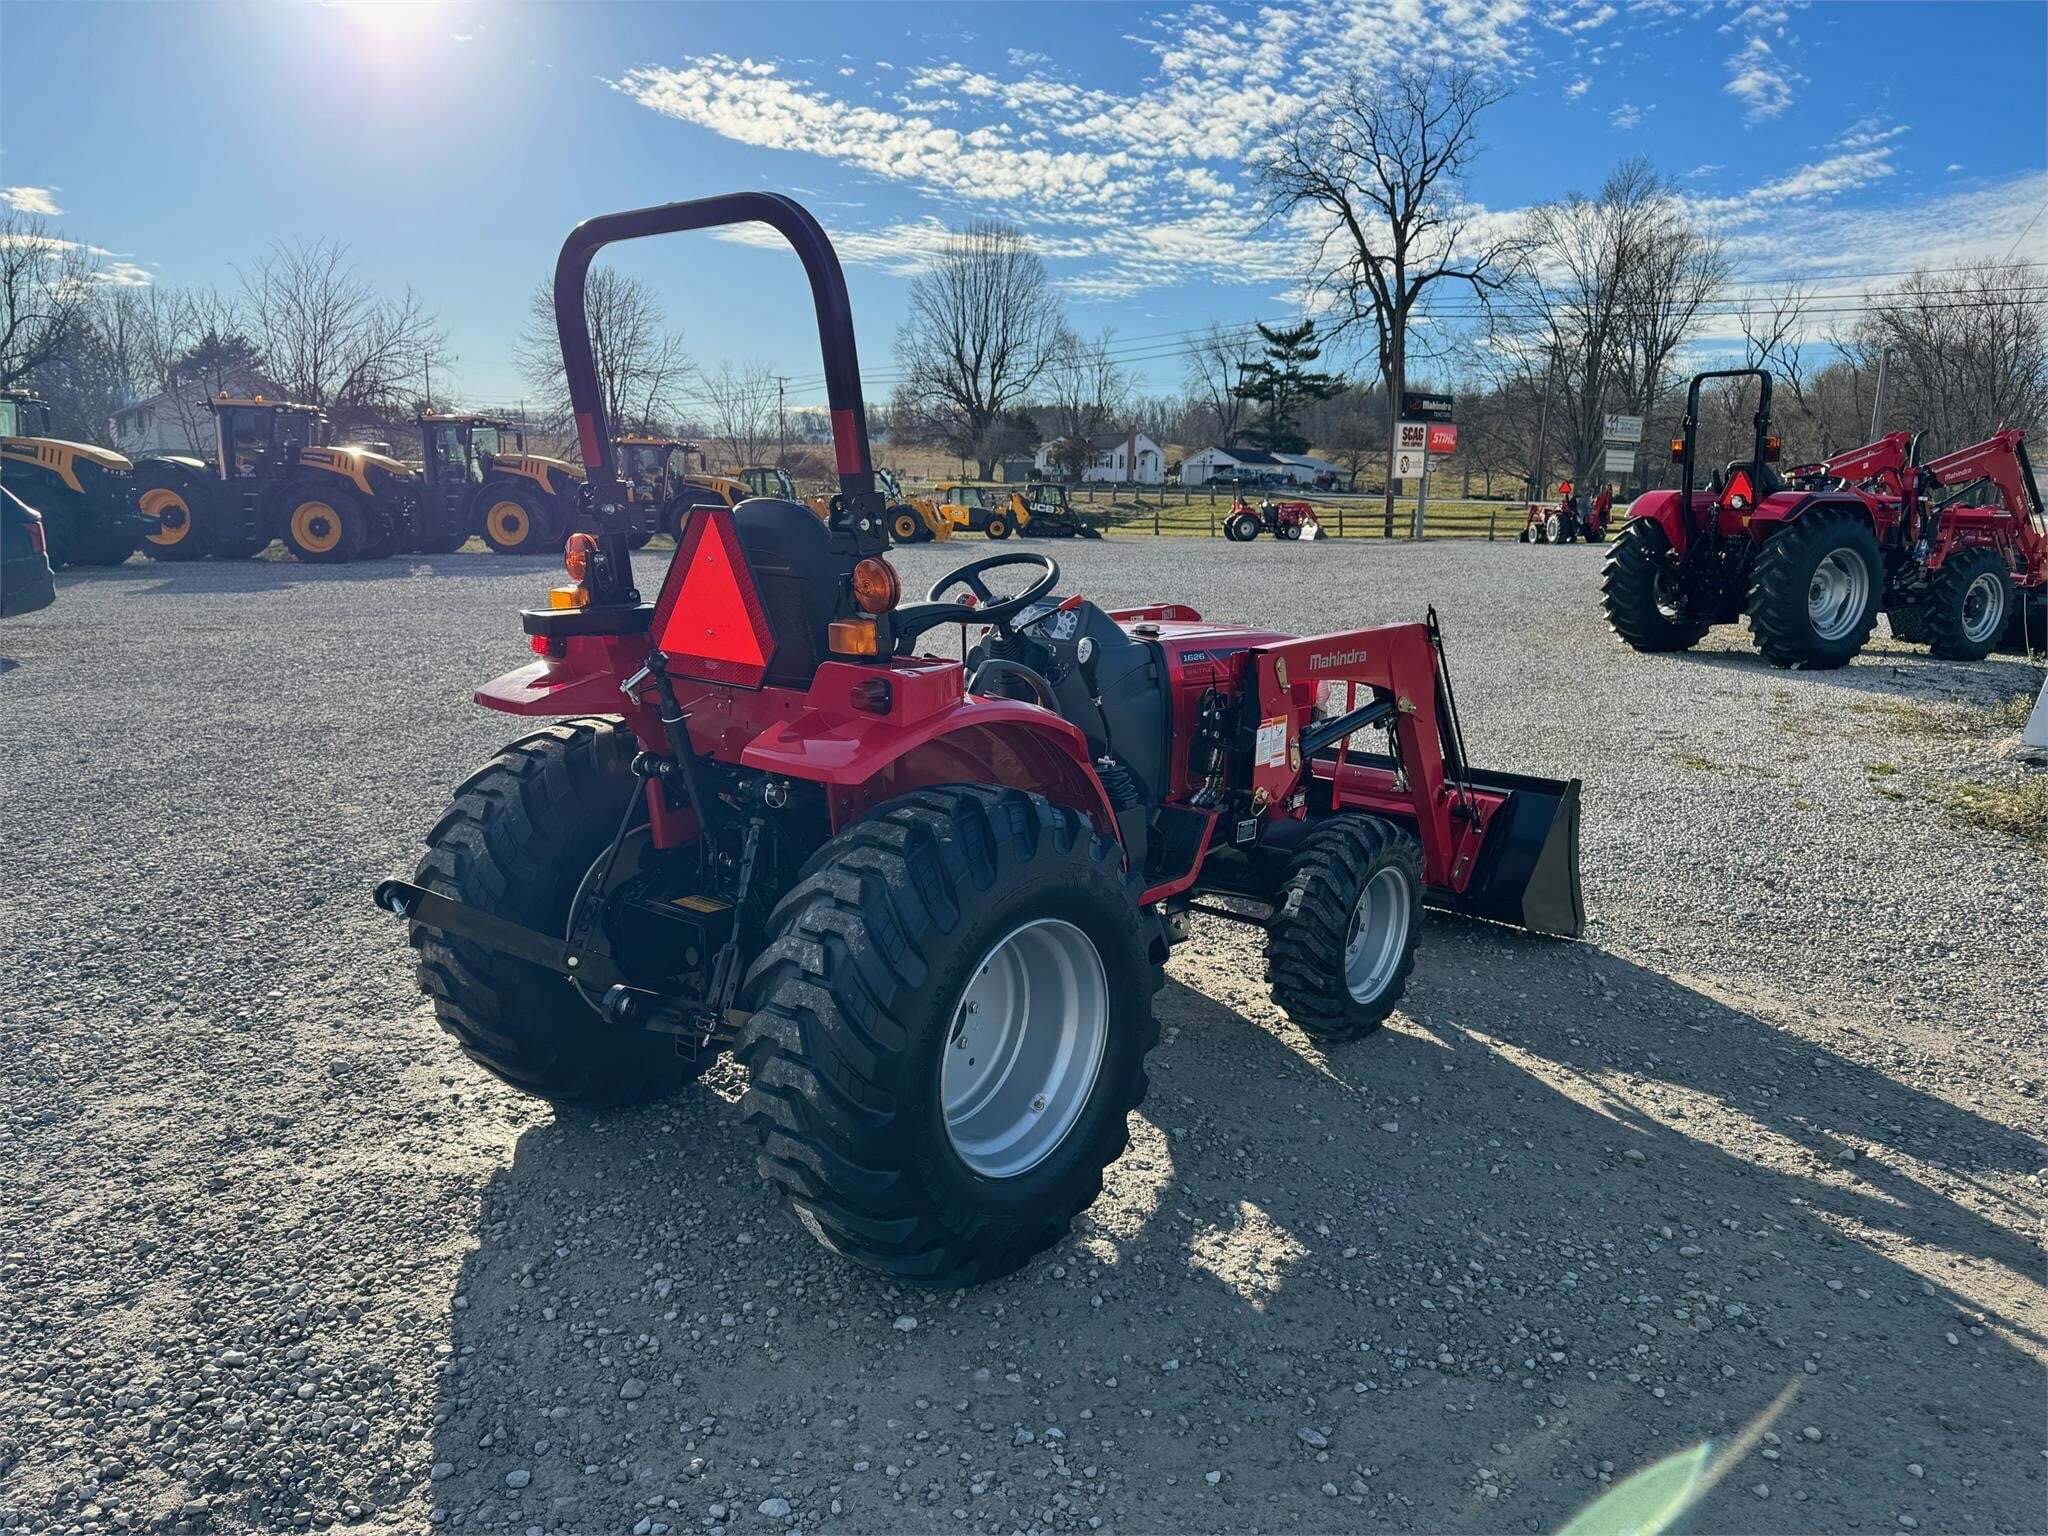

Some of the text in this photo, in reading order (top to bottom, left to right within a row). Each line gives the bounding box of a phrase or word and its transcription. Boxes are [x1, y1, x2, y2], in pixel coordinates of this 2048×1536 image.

[1402, 426, 1425, 442] SCAG
[1432, 432, 1456, 446] STIHL
[1029, 502, 1055, 514] JCB
[1183, 653, 1205, 662] 1626
[1309, 648, 1367, 671] Mahindra
